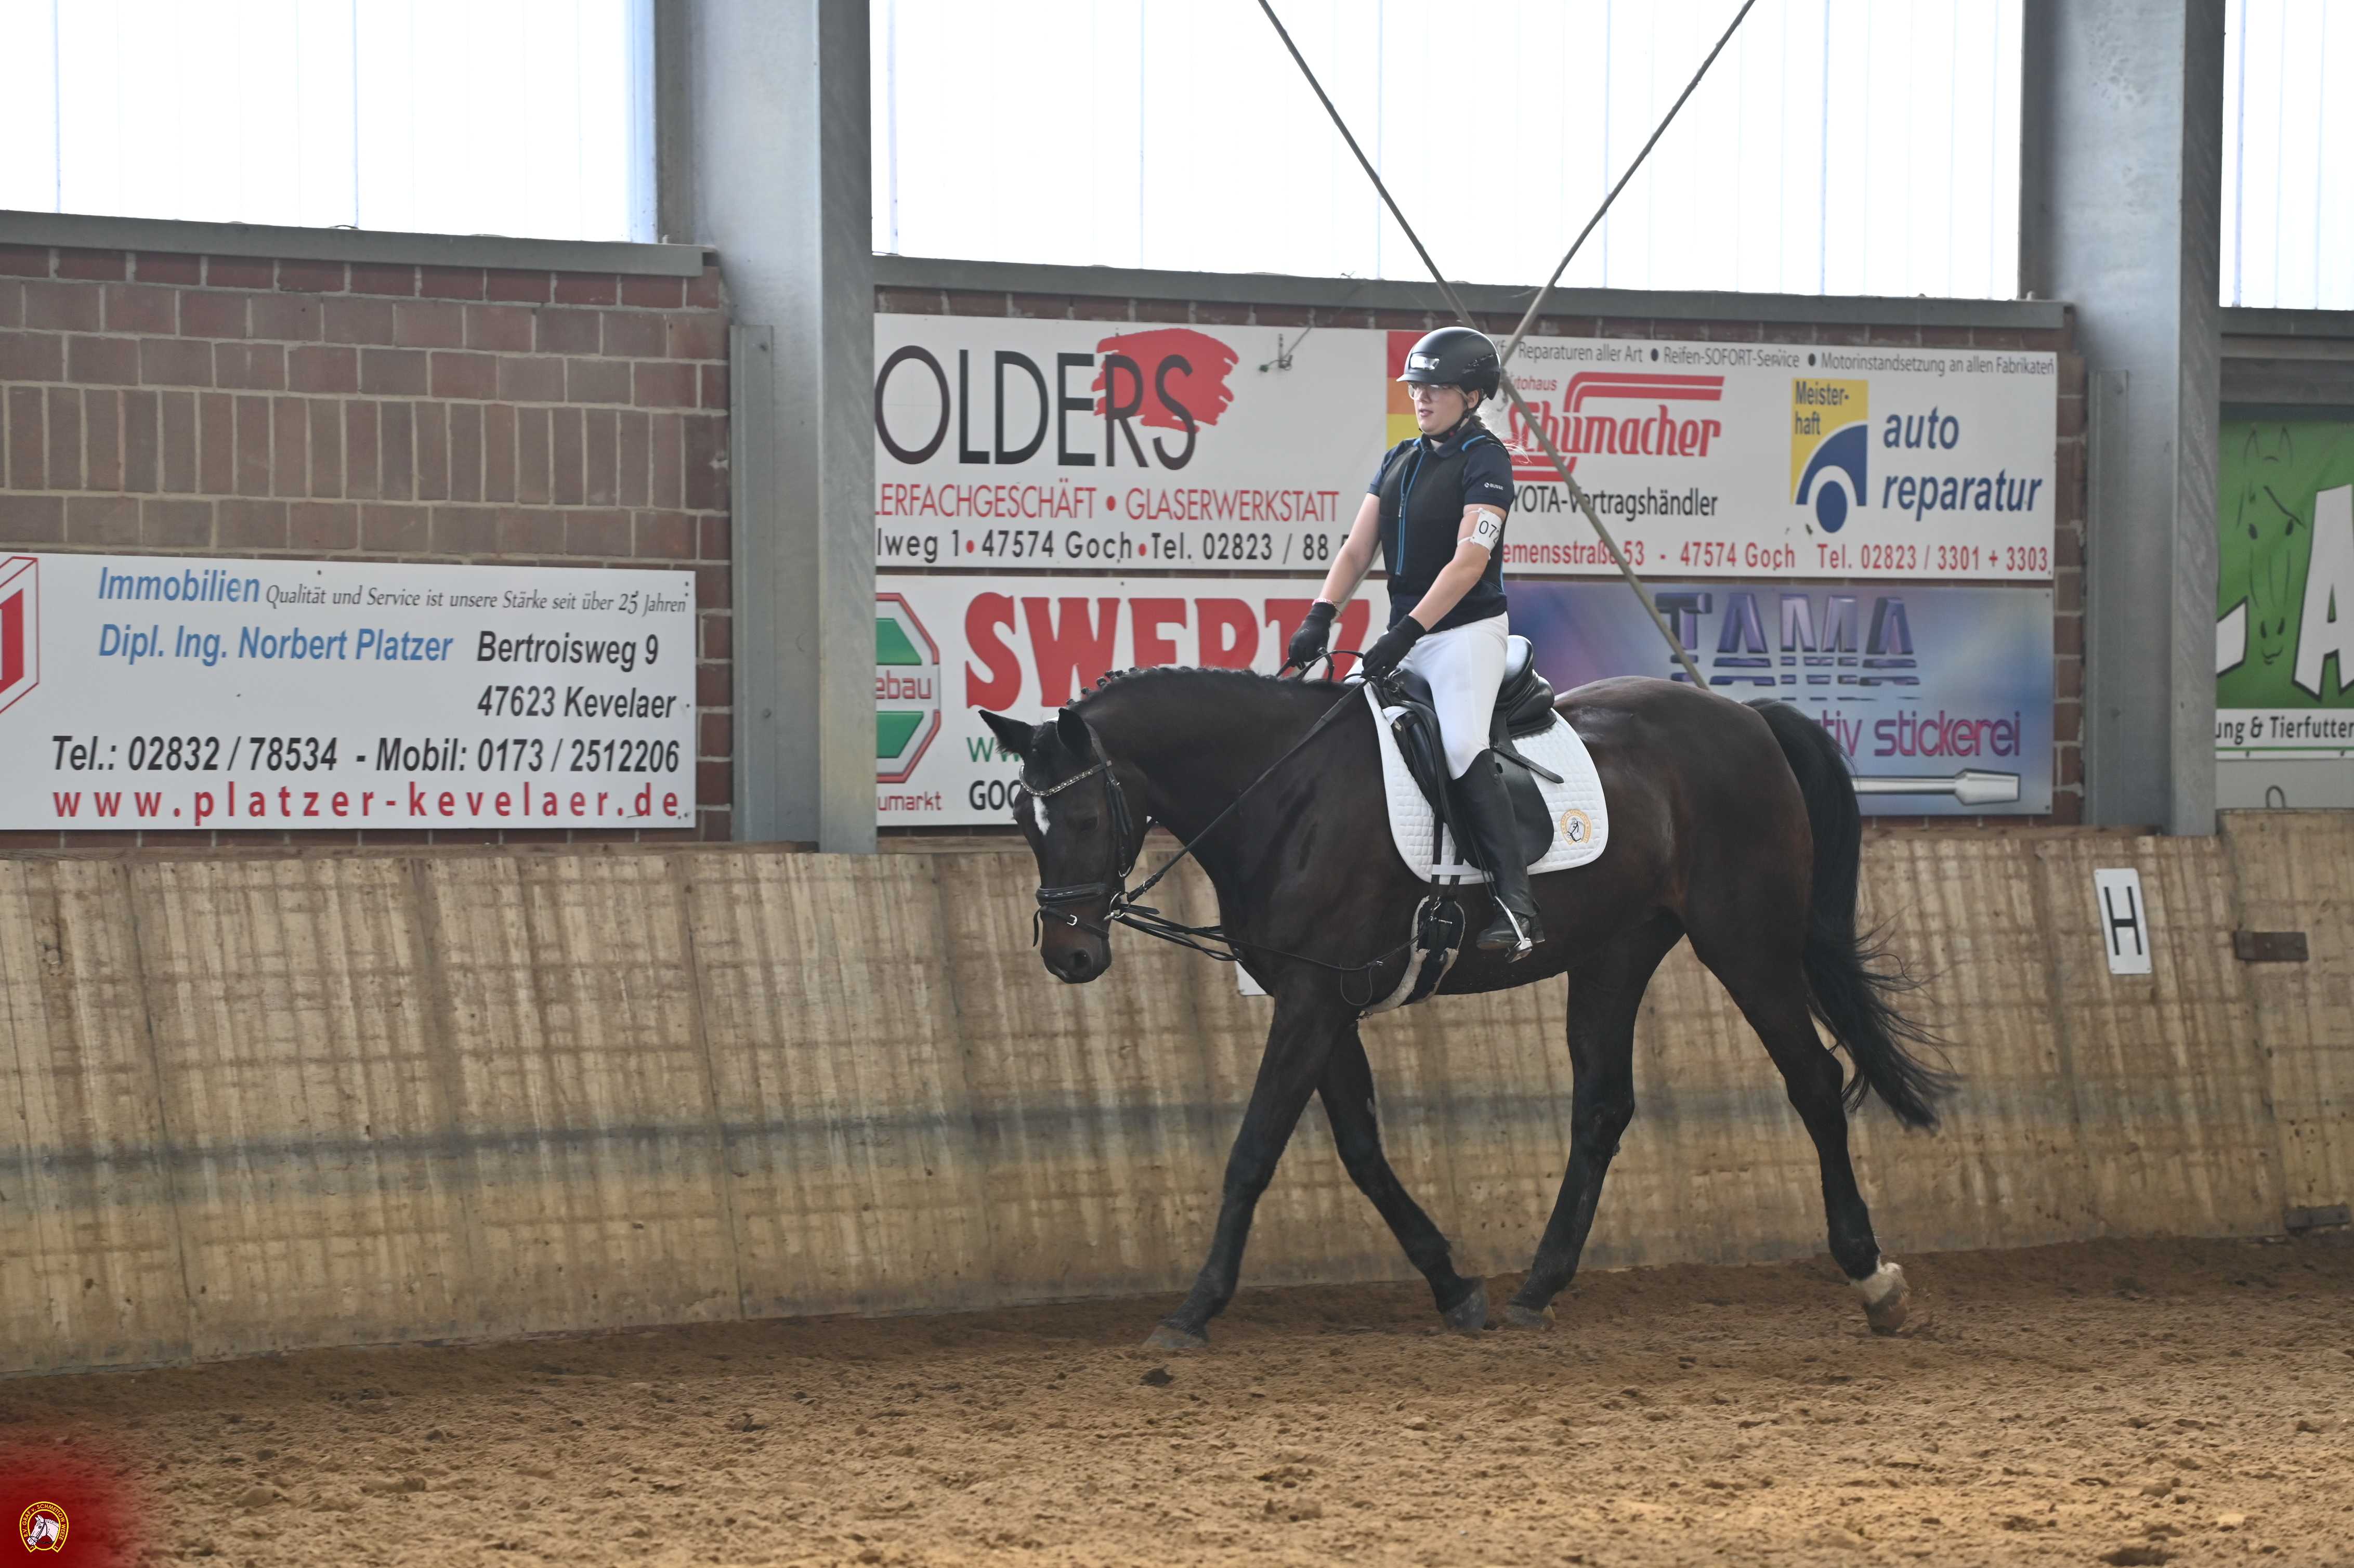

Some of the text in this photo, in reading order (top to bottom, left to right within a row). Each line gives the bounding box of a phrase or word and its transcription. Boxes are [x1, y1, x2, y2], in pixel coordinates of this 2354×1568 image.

[1518, 342, 1592, 363] Reparaturen
[1596, 345, 1621, 362] aller
[1625, 346, 1643, 363] Art
[1664, 346, 1799, 368] Reifen-SOFORT-Service
[1822, 352, 2055, 376] Motorinstandsetzung an allen Fabrikaten
[875, 345, 1197, 471] OLDERS
[1795, 381, 1849, 406] Meister-
[1795, 411, 1821, 435] haft
[1884, 406, 1959, 449] auto
[875, 478, 1340, 522] ERFACHGESCHÄFT GLASERWERKSTATT
[1882, 468, 2043, 521] reparatur
[951, 529, 959, 556] 1
[982, 529, 1054, 558] 47574
[1066, 531, 1132, 559] Goch
[1152, 532, 1192, 560] Tel.
[1203, 533, 1272, 560] 02823
[1303, 533, 1329, 560] 88
[1624, 540, 1645, 566] 53
[1680, 542, 1737, 567] 47574
[1745, 543, 1795, 568] Goch
[1817, 543, 1852, 569] Tel.
[1861, 544, 1917, 569] 02823
[1938, 545, 1979, 570] 3301
[2007, 546, 2048, 571] 3303
[98, 567, 686, 617] Immobilien Qualität und Service ist unsere Stärke seit über 25 Jahren
[99, 624, 453, 667] Dipl. Ing. Norbert Platzer
[477, 631, 659, 672] Bertroisweg 9
[1655, 592, 1920, 701] TAMA
[478, 685, 676, 718] 47623 Kevelaer
[1874, 710, 2021, 756] stickerei
[2251, 716, 2263, 738] &
[53, 736, 116, 770] Tel.:
[128, 736, 219, 770] 02832
[249, 737, 337, 771] 78534
[376, 737, 467, 772] Mobil:
[478, 738, 543, 772] 0173
[570, 739, 679, 773] 2512206
[53, 781, 678, 826] www.platzer-kevelaer.de
[878, 791, 942, 811] umarkt
[2104, 886, 2142, 956] H
